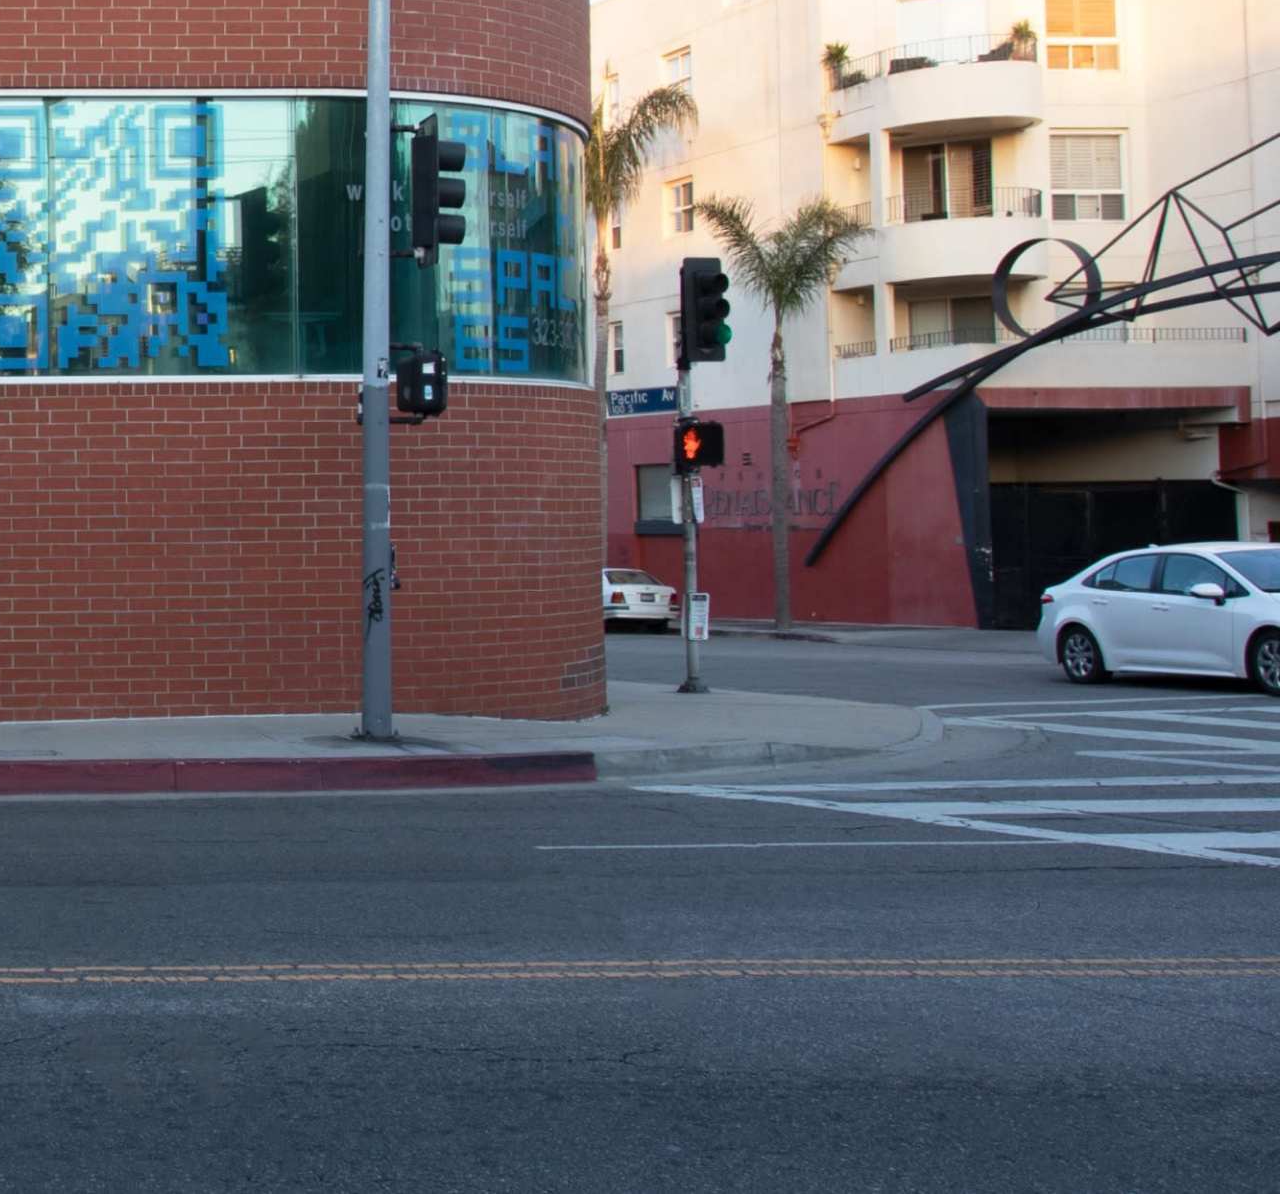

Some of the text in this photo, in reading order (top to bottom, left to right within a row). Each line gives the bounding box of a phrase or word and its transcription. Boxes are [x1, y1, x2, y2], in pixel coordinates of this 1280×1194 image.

[346, 180, 404, 201] wk
[610, 388, 675, 405] Pacific Av
